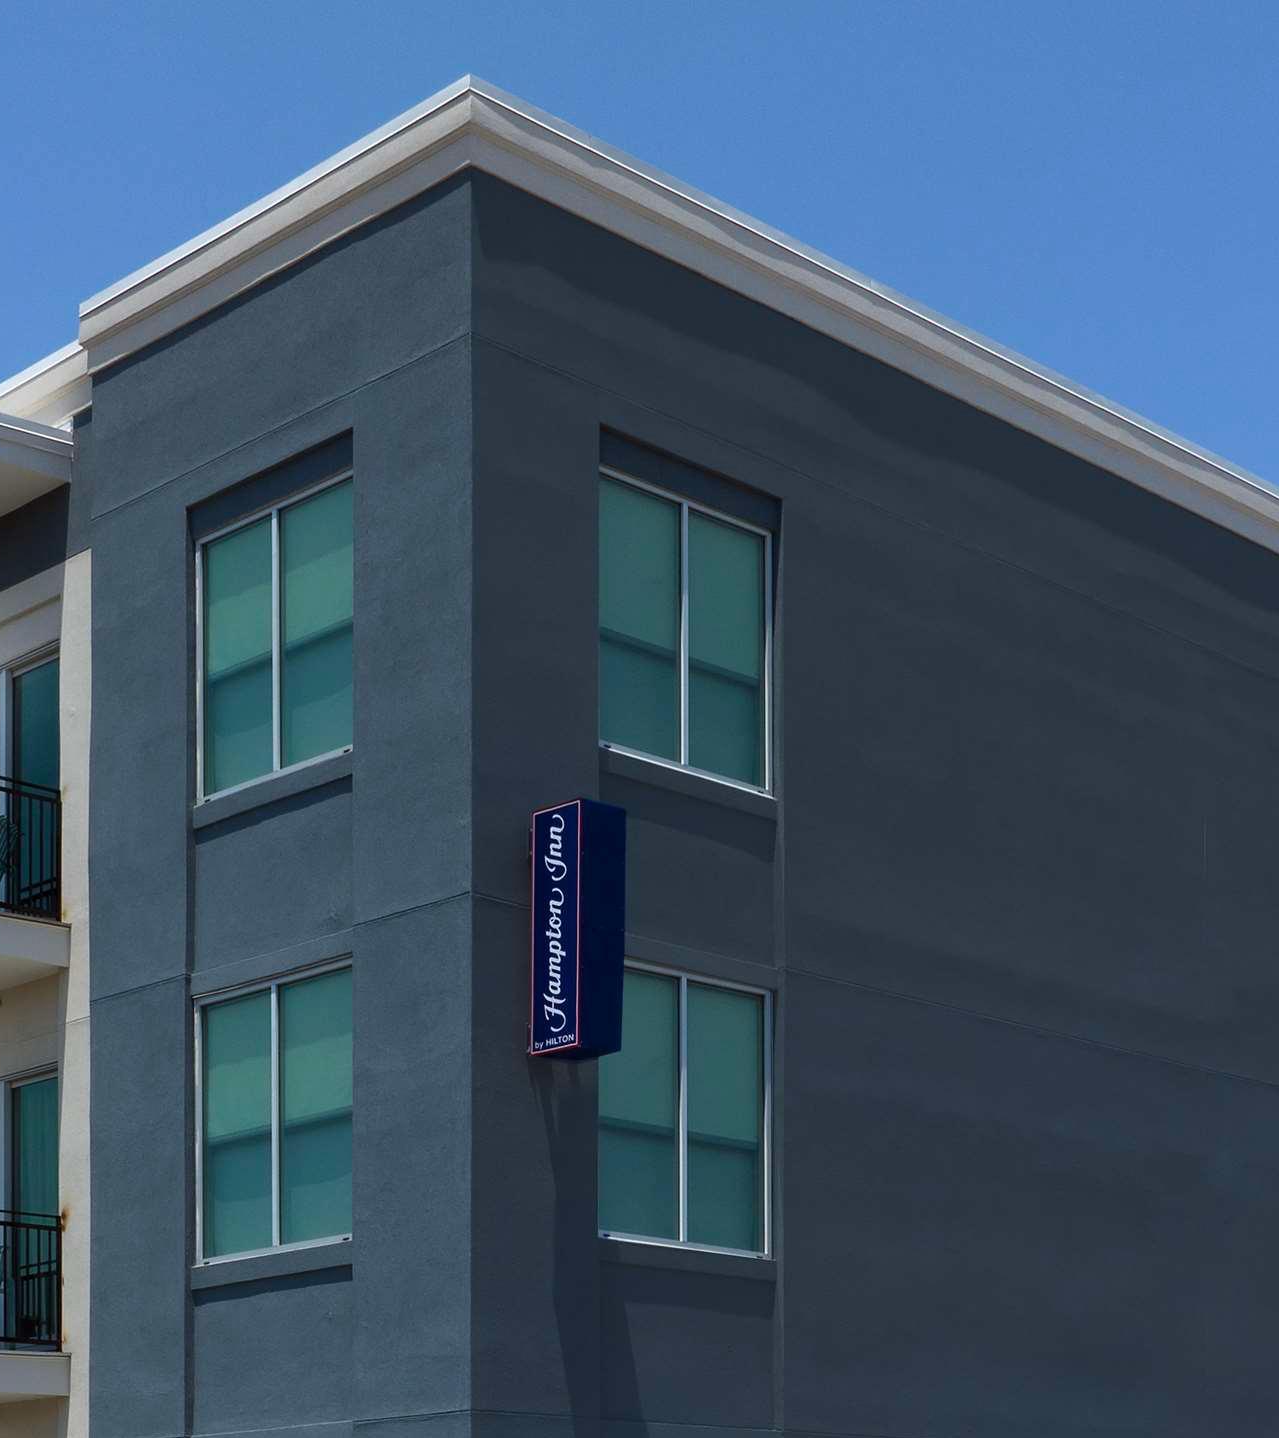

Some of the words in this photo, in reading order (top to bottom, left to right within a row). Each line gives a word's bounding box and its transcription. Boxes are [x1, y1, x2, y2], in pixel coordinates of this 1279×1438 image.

[544, 814, 567, 882] Inn
[543, 887, 567, 1032] Hampton
[534, 1040, 544, 1049] by
[545, 1033, 575, 1047] HILTON
